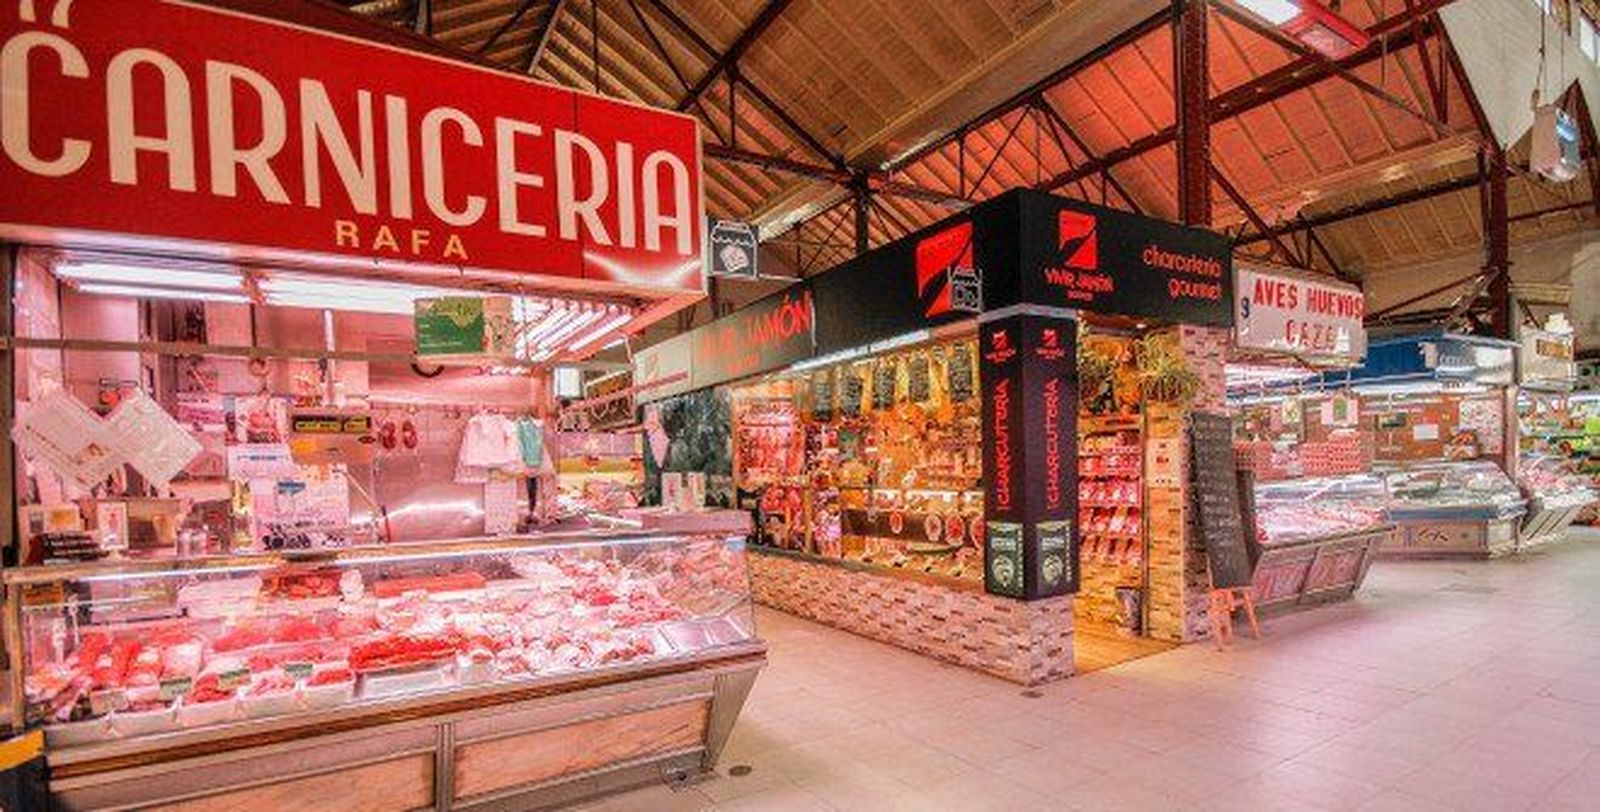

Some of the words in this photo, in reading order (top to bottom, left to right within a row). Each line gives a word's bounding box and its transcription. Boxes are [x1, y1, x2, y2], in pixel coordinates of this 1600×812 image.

[1, 31, 692, 255] CARNICERIA
[335, 219, 468, 259] RAFA
[1253, 278, 1298, 311] AVES
[1305, 287, 1364, 320] HUEVOS
